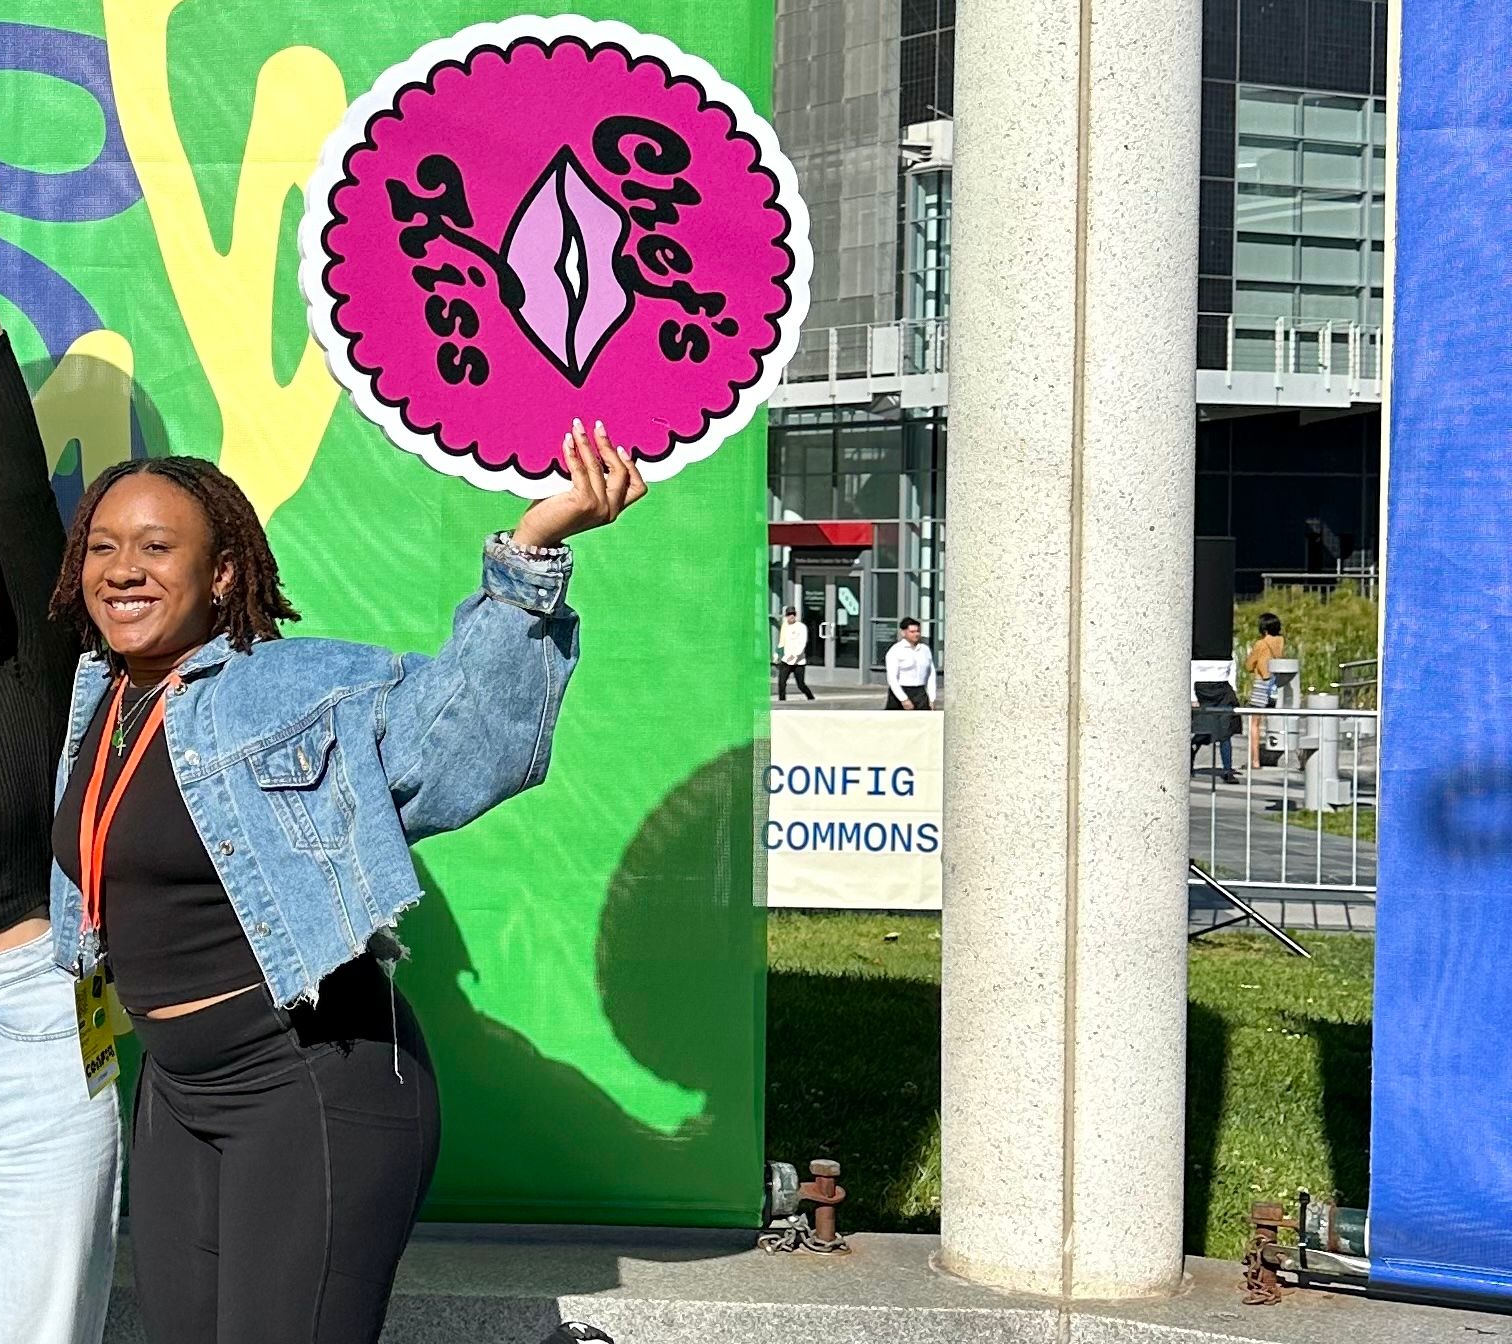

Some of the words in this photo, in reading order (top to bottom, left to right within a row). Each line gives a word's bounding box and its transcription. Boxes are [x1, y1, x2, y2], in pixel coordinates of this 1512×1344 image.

[385, 154, 526, 387] Kiss
[592, 115, 739, 364] Chef's
[760, 820, 940, 853] COMMONS
[762, 764, 915, 797] CONFIG
